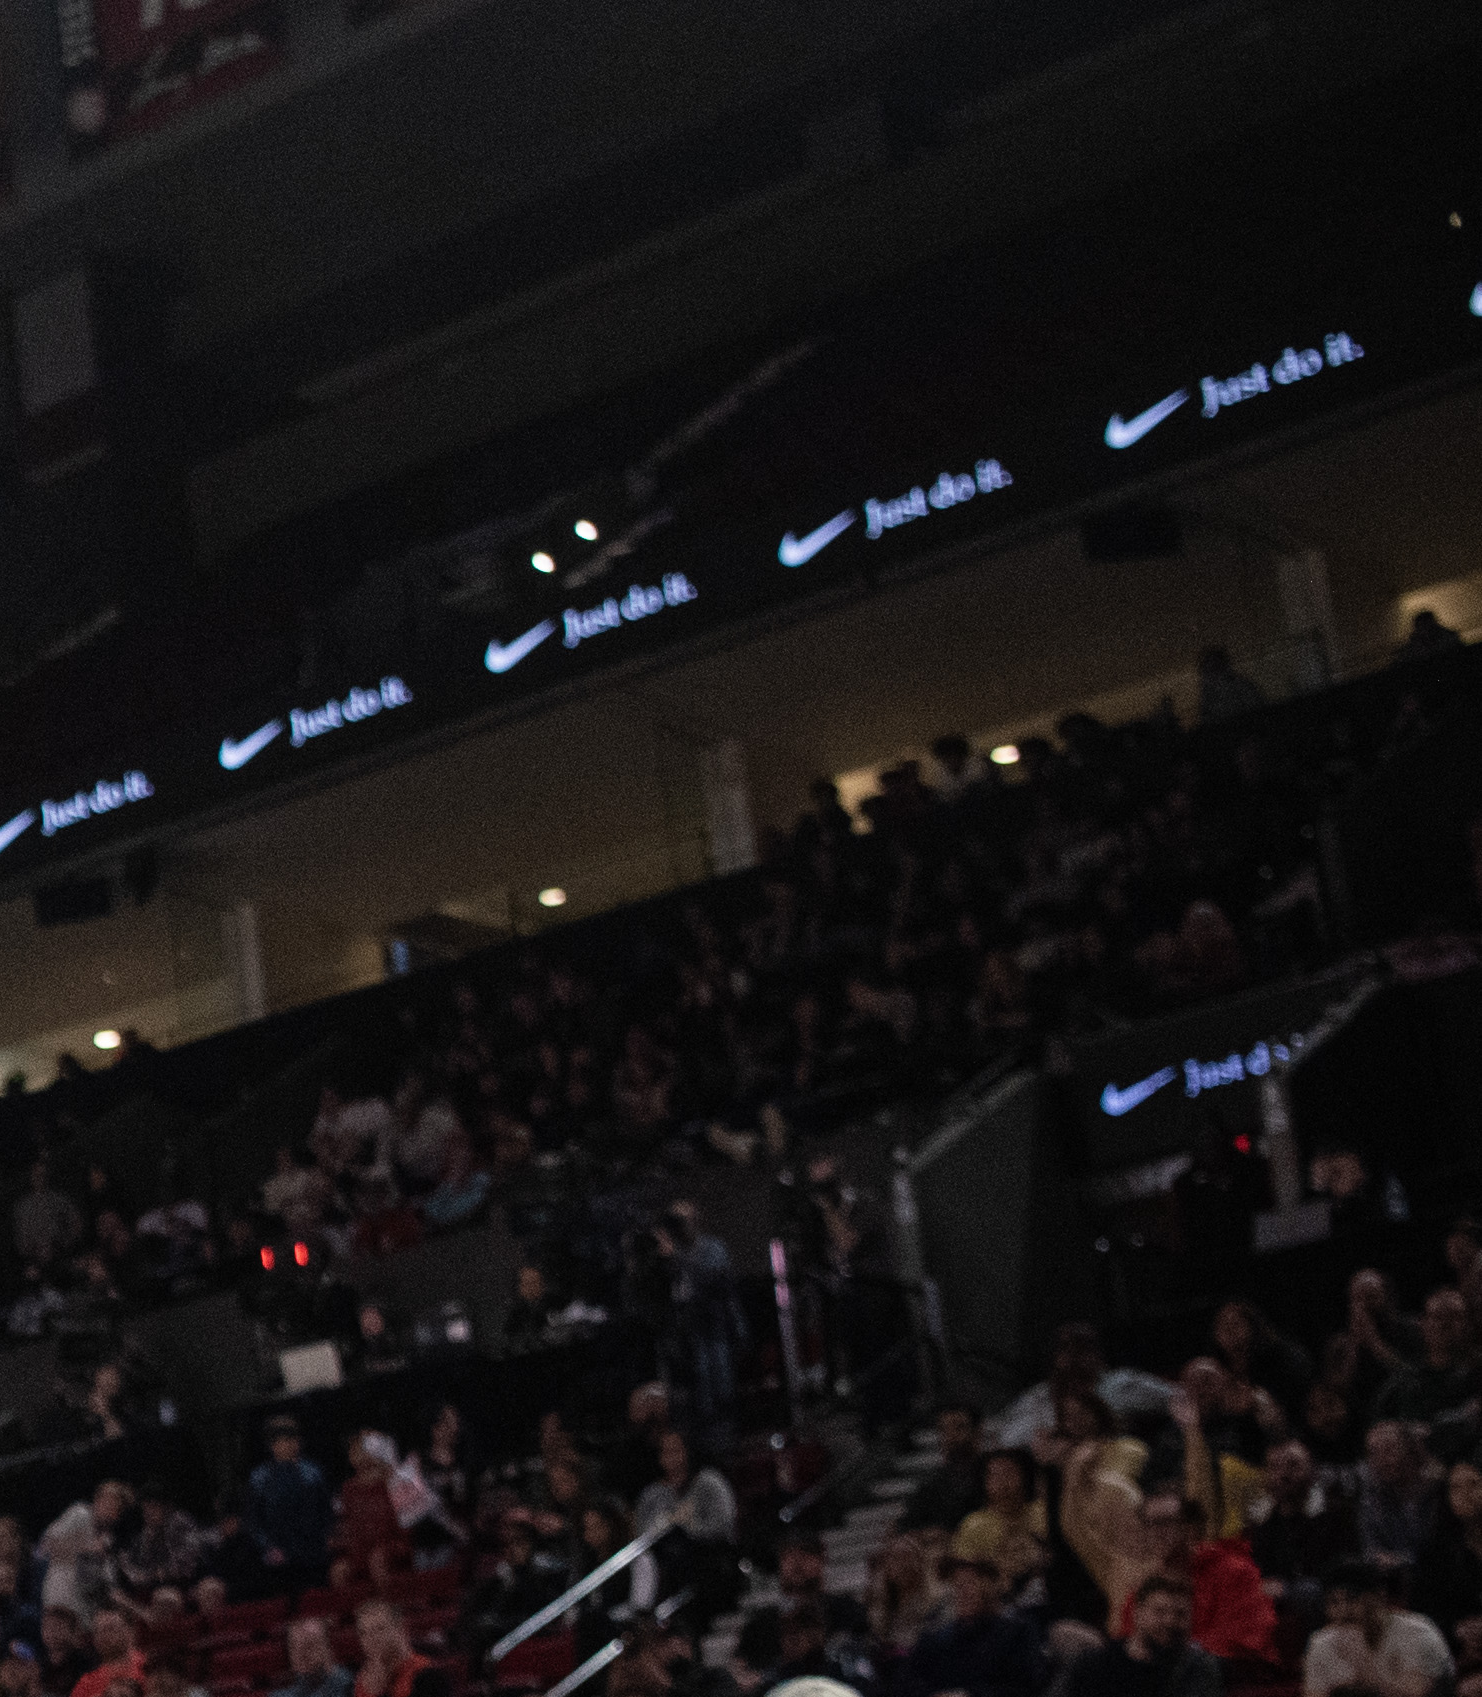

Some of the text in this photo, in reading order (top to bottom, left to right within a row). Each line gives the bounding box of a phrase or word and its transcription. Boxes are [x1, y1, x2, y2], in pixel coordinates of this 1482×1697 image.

[1201, 364, 1270, 418] Just
[1272, 348, 1323, 384] do
[865, 487, 929, 539] Just
[929, 473, 976, 509] do
[563, 599, 621, 648] Just
[621, 578, 664, 621] do
[290, 701, 343, 747] Just
[343, 681, 382, 722] do
[41, 793, 90, 836] Just
[90, 781, 124, 814] do
